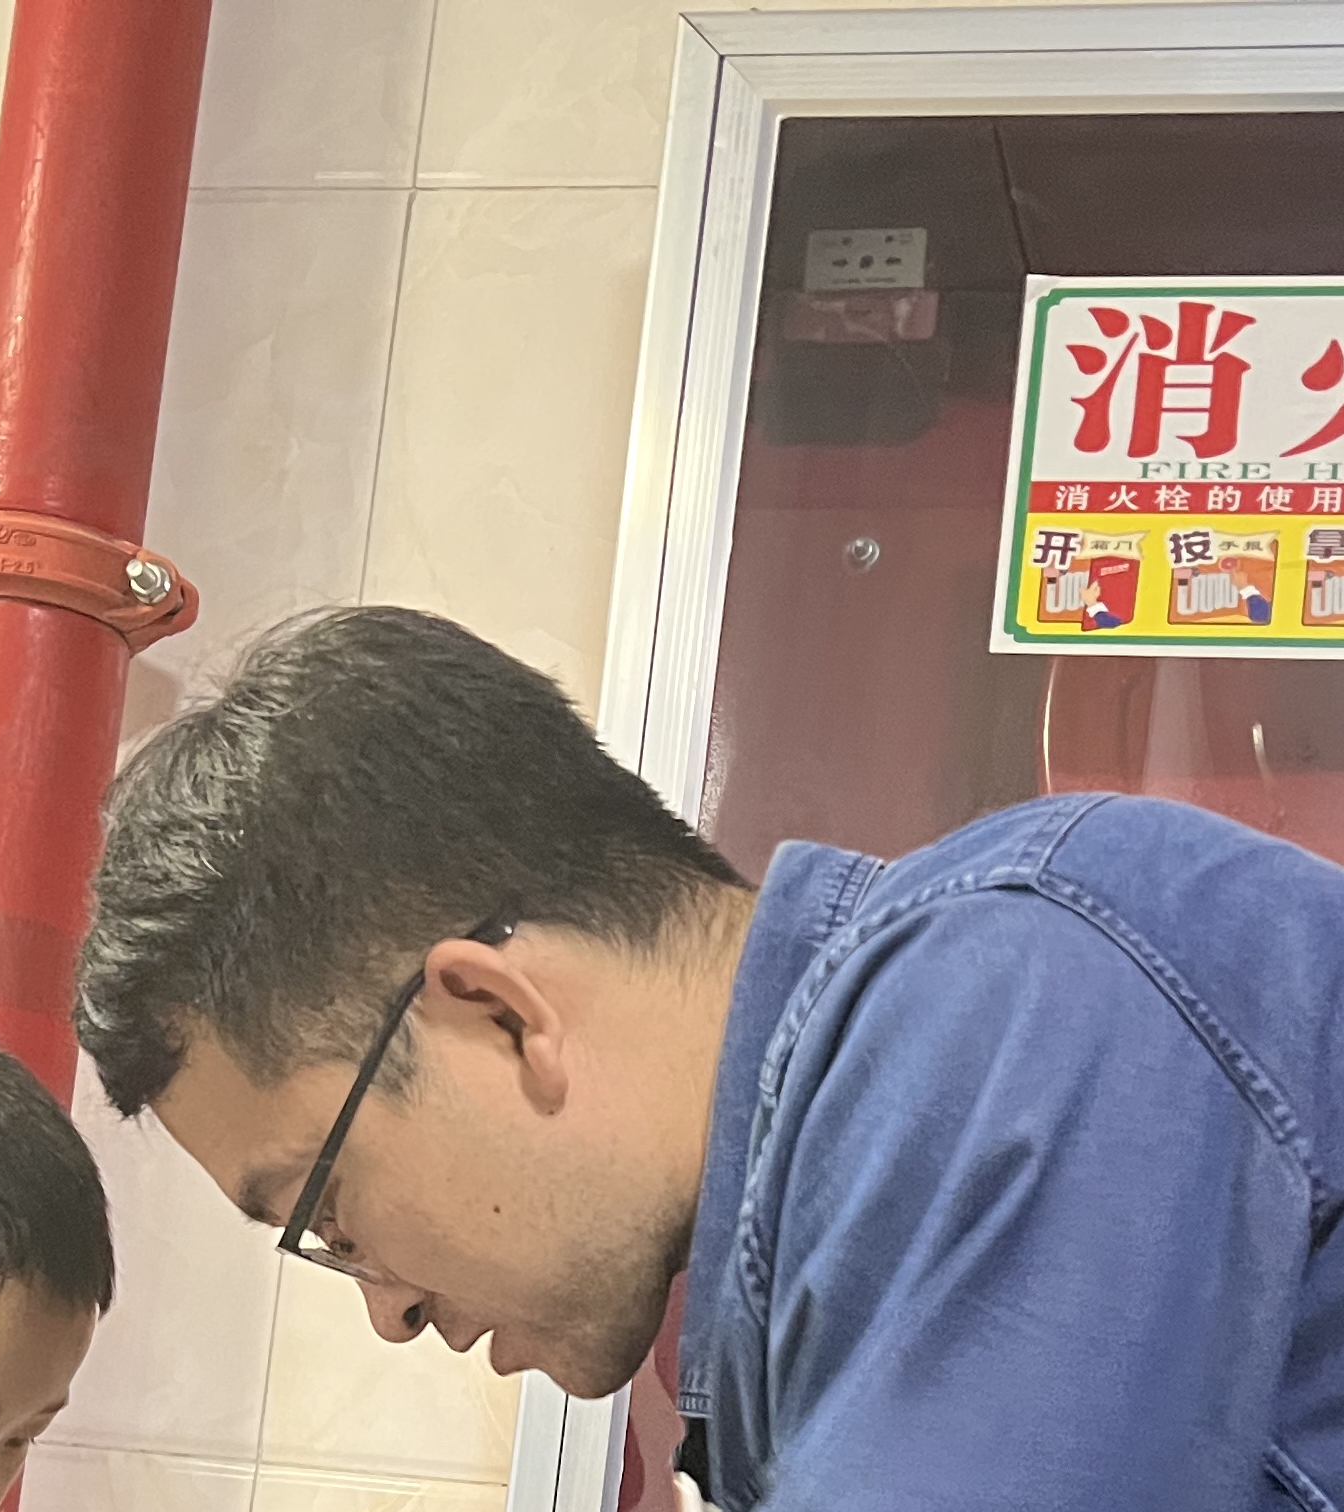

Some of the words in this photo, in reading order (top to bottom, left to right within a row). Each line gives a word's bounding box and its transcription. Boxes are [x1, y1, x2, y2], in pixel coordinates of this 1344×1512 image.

[1137, 461, 1272, 480] FIRE
[1033, 530, 1079, 565] 开
[1169, 531, 1213, 564] 按
